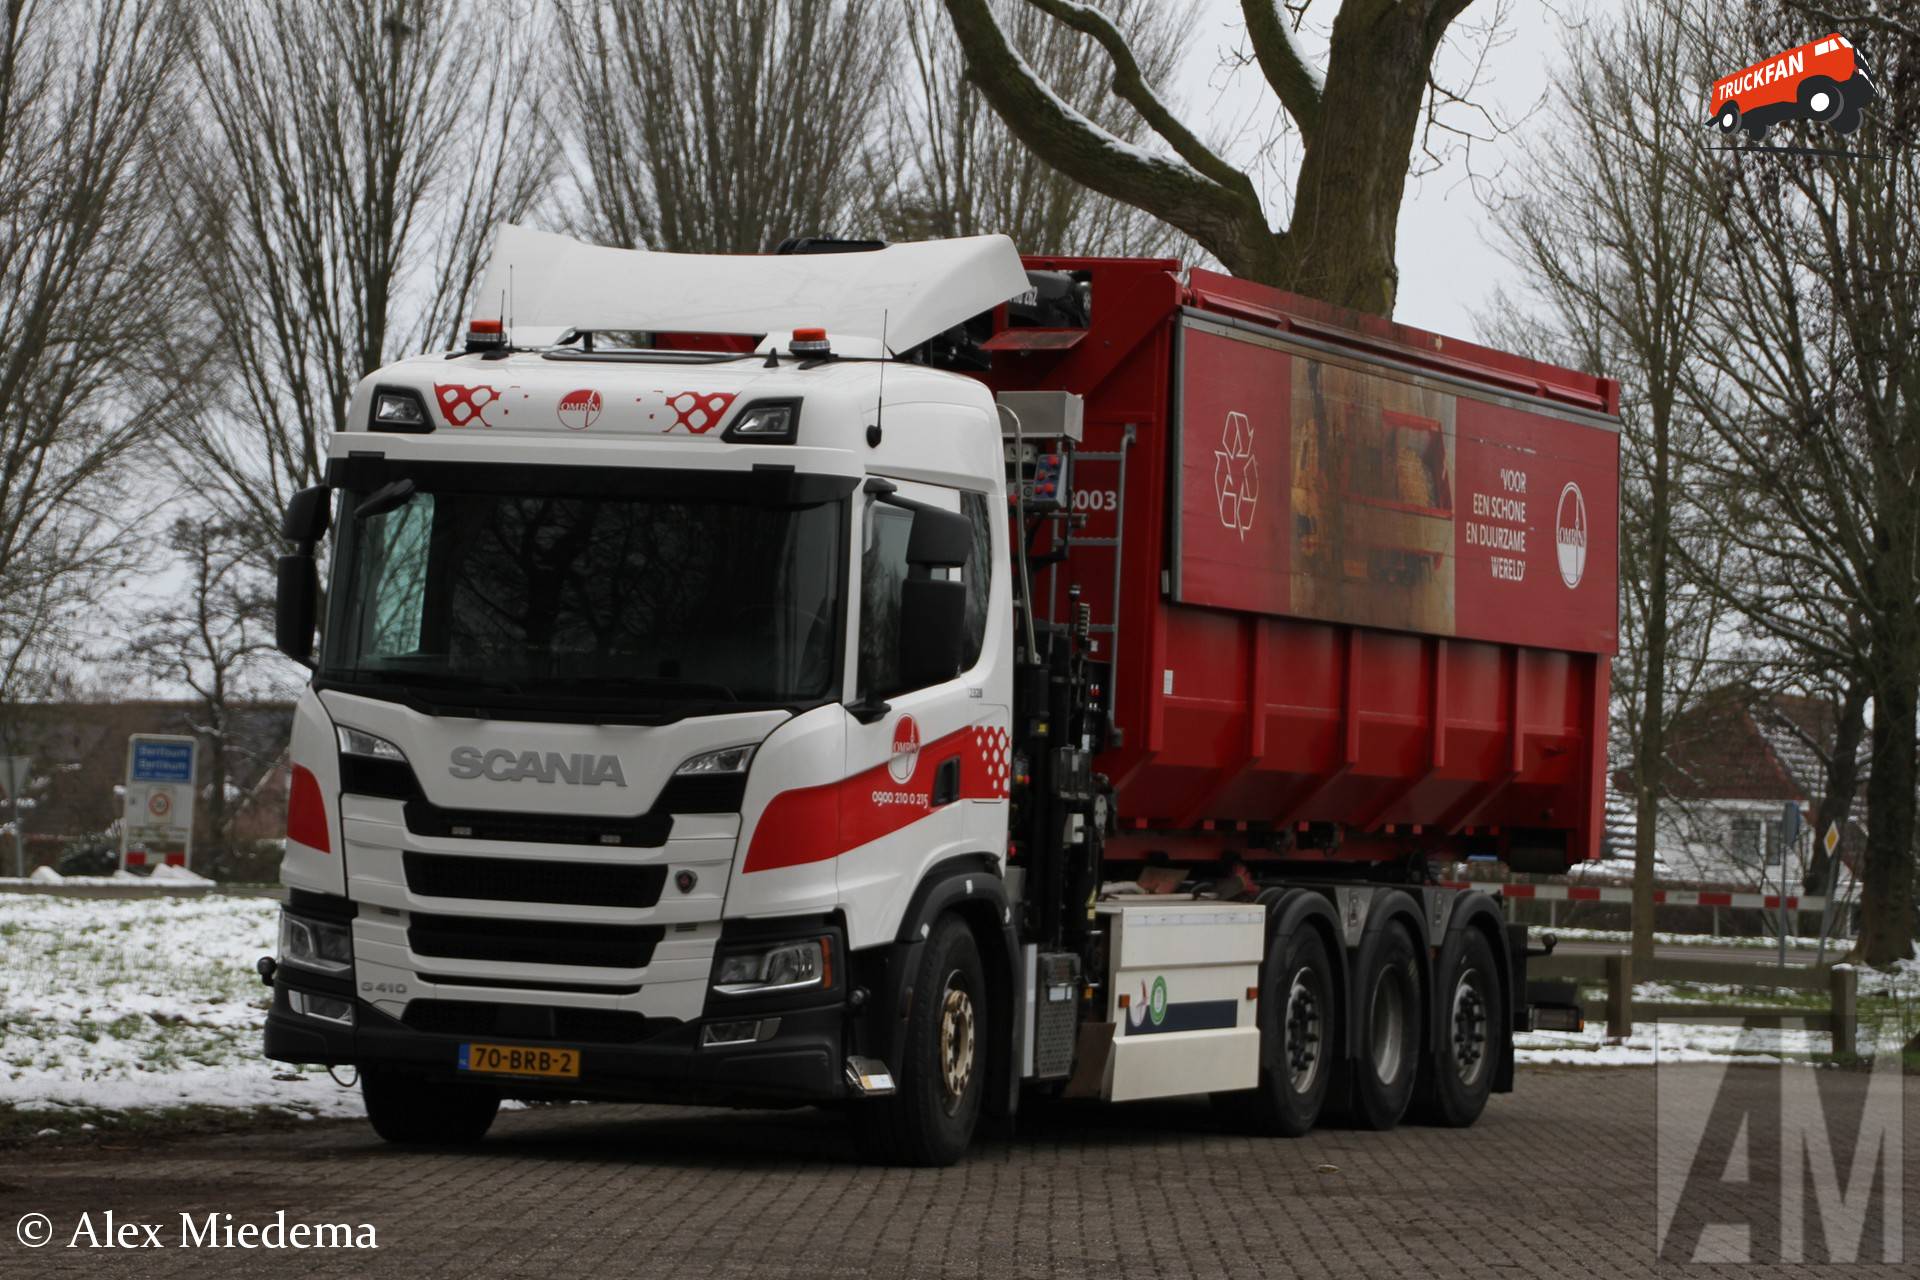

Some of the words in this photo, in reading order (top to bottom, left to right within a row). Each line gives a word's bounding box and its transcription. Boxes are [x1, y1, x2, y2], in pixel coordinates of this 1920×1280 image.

[1473, 493, 1490, 516] EEN
[1491, 495, 1526, 523] SCHONE
[1466, 522, 1478, 545] EN
[1480, 523, 1526, 552] DUURZAME
[448, 745, 628, 787] SCANIA
[871, 790, 894, 807] 0900
[909, 792, 916, 805] 0
[474, 1047, 572, 1073] 70-BRB-2
